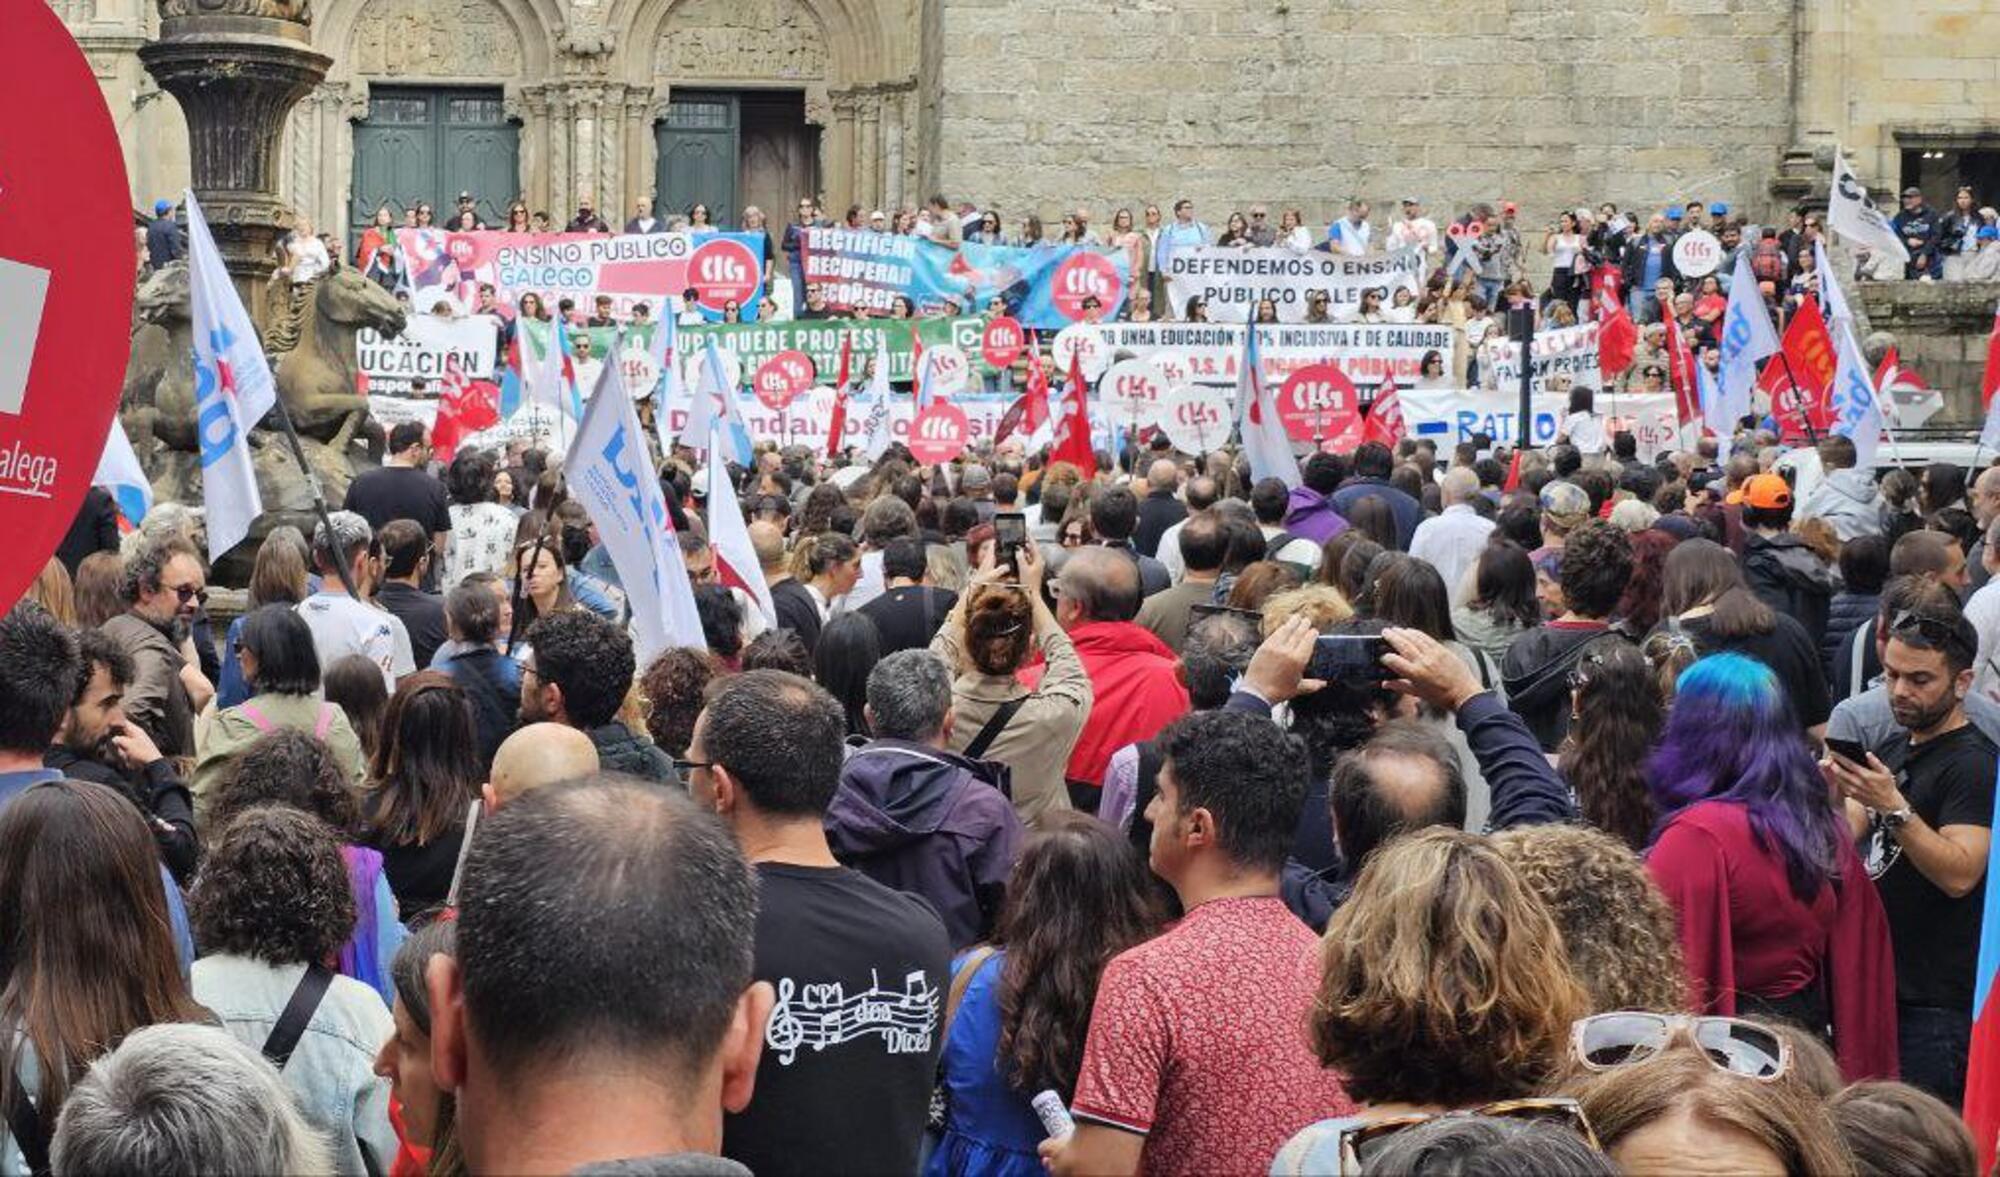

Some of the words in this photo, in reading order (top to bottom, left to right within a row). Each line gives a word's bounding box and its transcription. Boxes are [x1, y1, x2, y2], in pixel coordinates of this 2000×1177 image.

[702, 255, 746, 282] CIG
[1172, 258, 1314, 276] DEFENDEMOS
[1322, 261, 1336, 276] O
[820, 282, 896, 310] ECOÑECE
[795, 328, 882, 351] PROFES
[1121, 329, 1156, 346] UNHA
[1160, 326, 1235, 346] EDUCACIÓN
[1279, 330, 1348, 347] INCLUSIVA
[1353, 331, 1361, 346] E
[1366, 331, 1381, 347] DE
[1387, 330, 1450, 348] CALIDADE
[361, 346, 478, 373] UCACIÓN
[0, 440, 57, 492] alega
